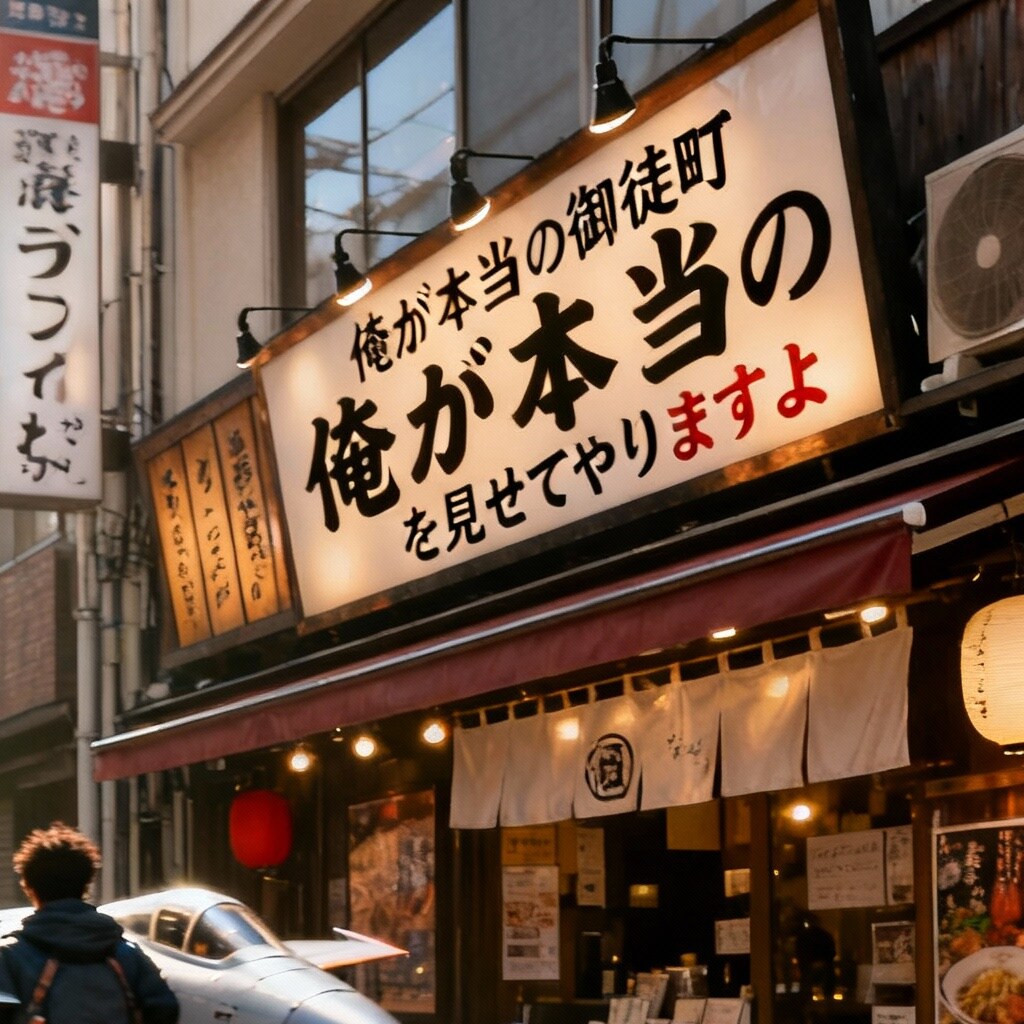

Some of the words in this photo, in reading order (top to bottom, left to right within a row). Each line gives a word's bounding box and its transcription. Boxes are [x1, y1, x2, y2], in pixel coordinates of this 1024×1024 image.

[305, 189, 833, 533] 俺が本当の
[350, 109, 732, 383] 俺が本当の御徒町
[403, 342, 829, 562] を見せてやりますよ
